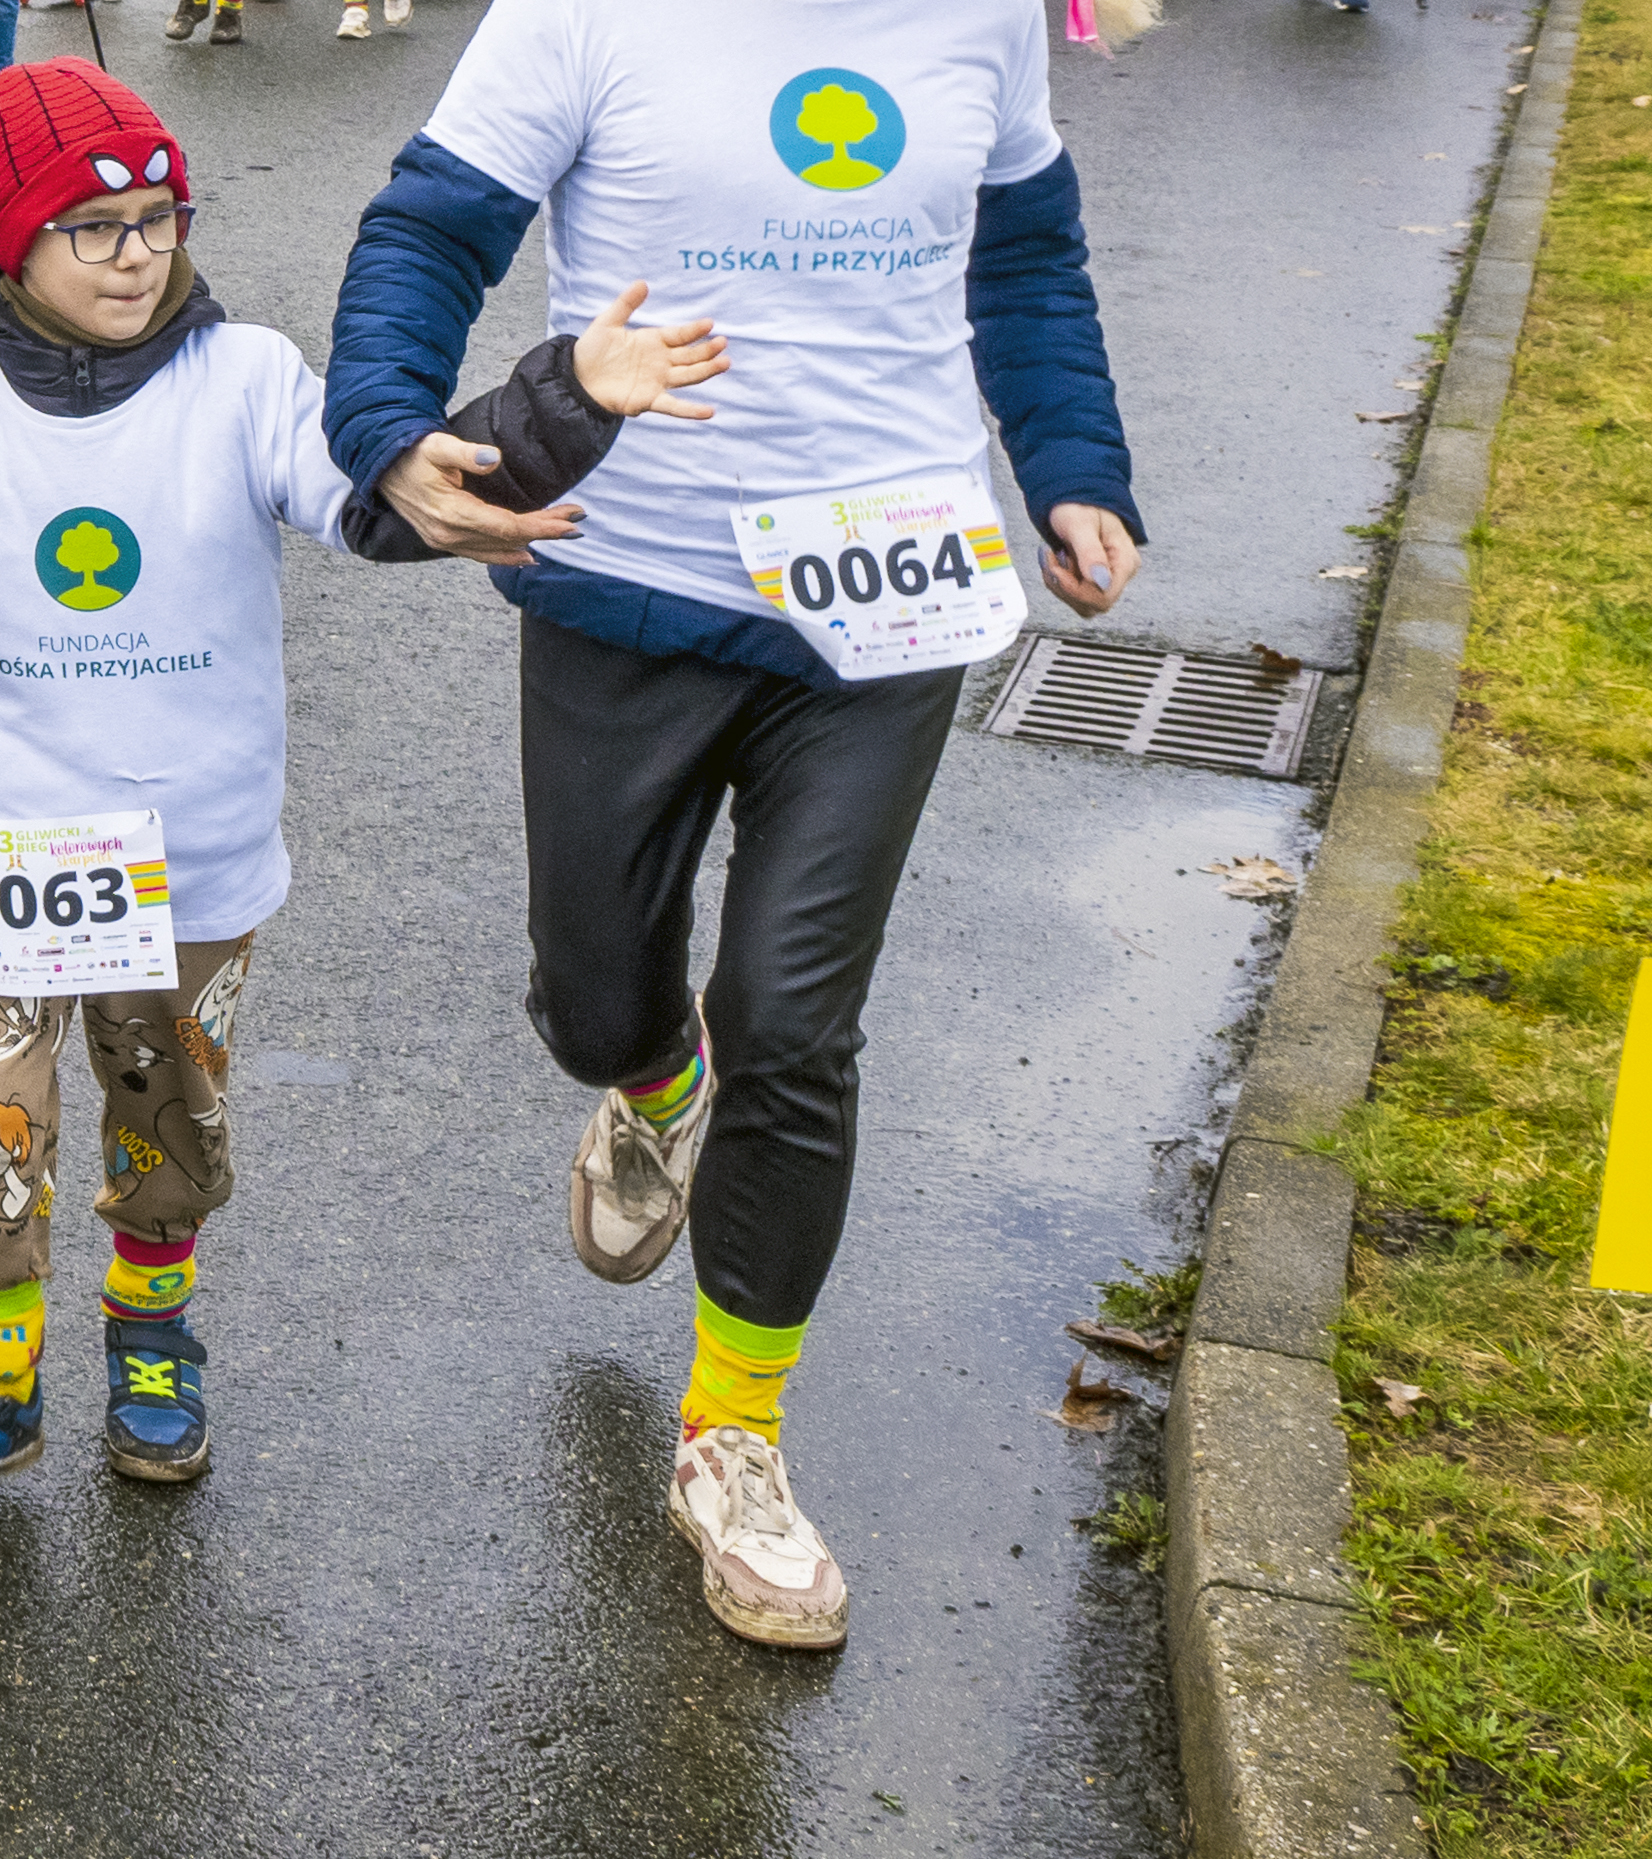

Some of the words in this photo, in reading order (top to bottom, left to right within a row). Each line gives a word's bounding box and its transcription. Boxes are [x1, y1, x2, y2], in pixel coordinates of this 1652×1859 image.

[763, 217, 914, 243] FUNDACJA
[678, 245, 781, 272] TOŚKA
[829, 501, 848, 526] 3
[849, 491, 914, 510] GLIWICKI
[851, 510, 883, 524] BIEG
[789, 532, 974, 611] 0064
[37, 631, 151, 654] FUNDACJA
[75, 650, 213, 680] PRZYJACIELE
[15, 827, 81, 842] GLIWICKI
[16, 841, 47, 853] BIEG
[49, 837, 124, 856] kolorowych
